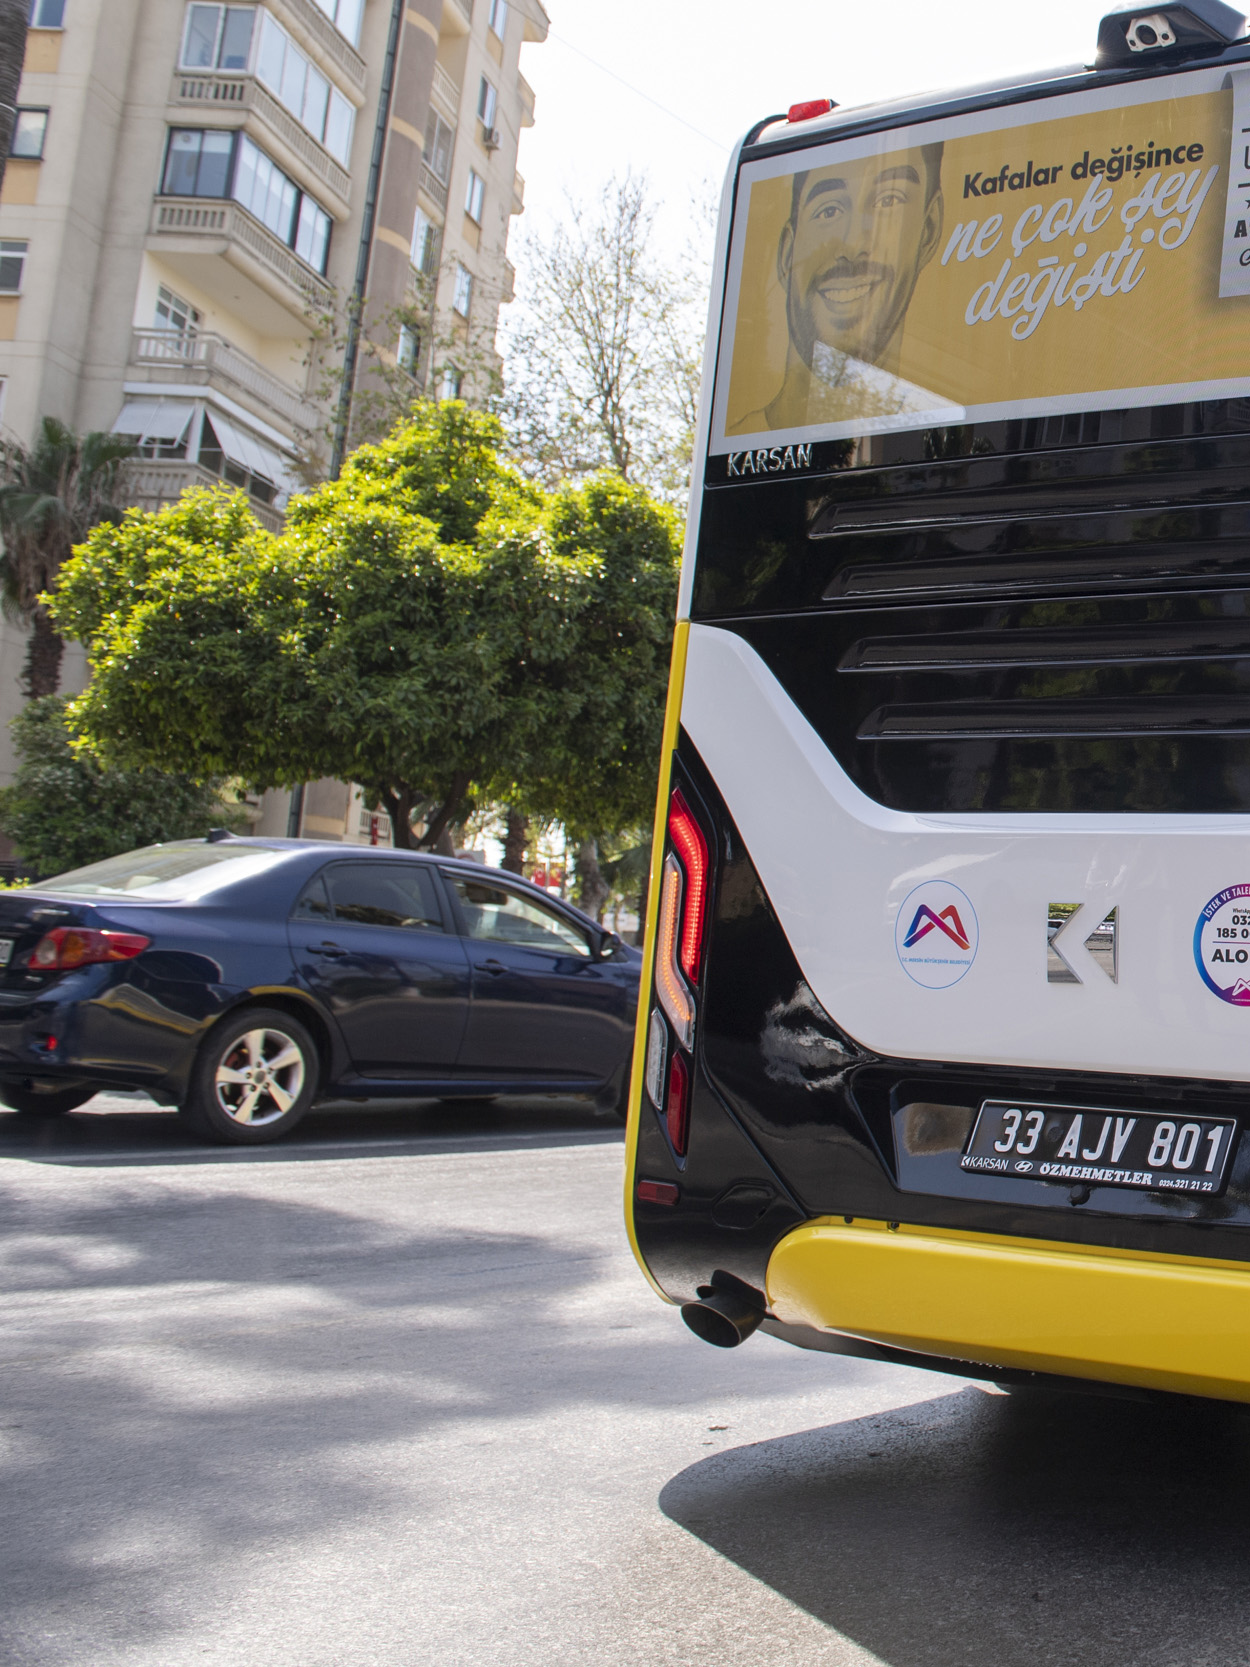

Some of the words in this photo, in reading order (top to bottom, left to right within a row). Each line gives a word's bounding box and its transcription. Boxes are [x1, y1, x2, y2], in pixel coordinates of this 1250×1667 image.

[963, 161, 1063, 198] Kafalar
[1071, 141, 1204, 182] değişince
[940, 213, 1003, 266] ne
[1011, 173, 1114, 258] çok
[1120, 164, 1220, 250] şey
[965, 228, 1155, 341] değişti
[727, 443, 813, 477] KARSAN
[1202, 897, 1222, 918] İSTEK
[1221, 890, 1231, 901] VE
[1217, 927, 1237, 938] 185
[1211, 948, 1248, 963] ALO
[994, 1109, 1045, 1155] 33
[1057, 1113, 1138, 1163] AJV
[1147, 1121, 1224, 1173] 801
[969, 1157, 1009, 1170] KARSAN
[1039, 1162, 1153, 1185] ÖZMEHMETLER
[1190, 1180, 1200, 1190] 21
[1201, 1181, 1213, 1191] 22
